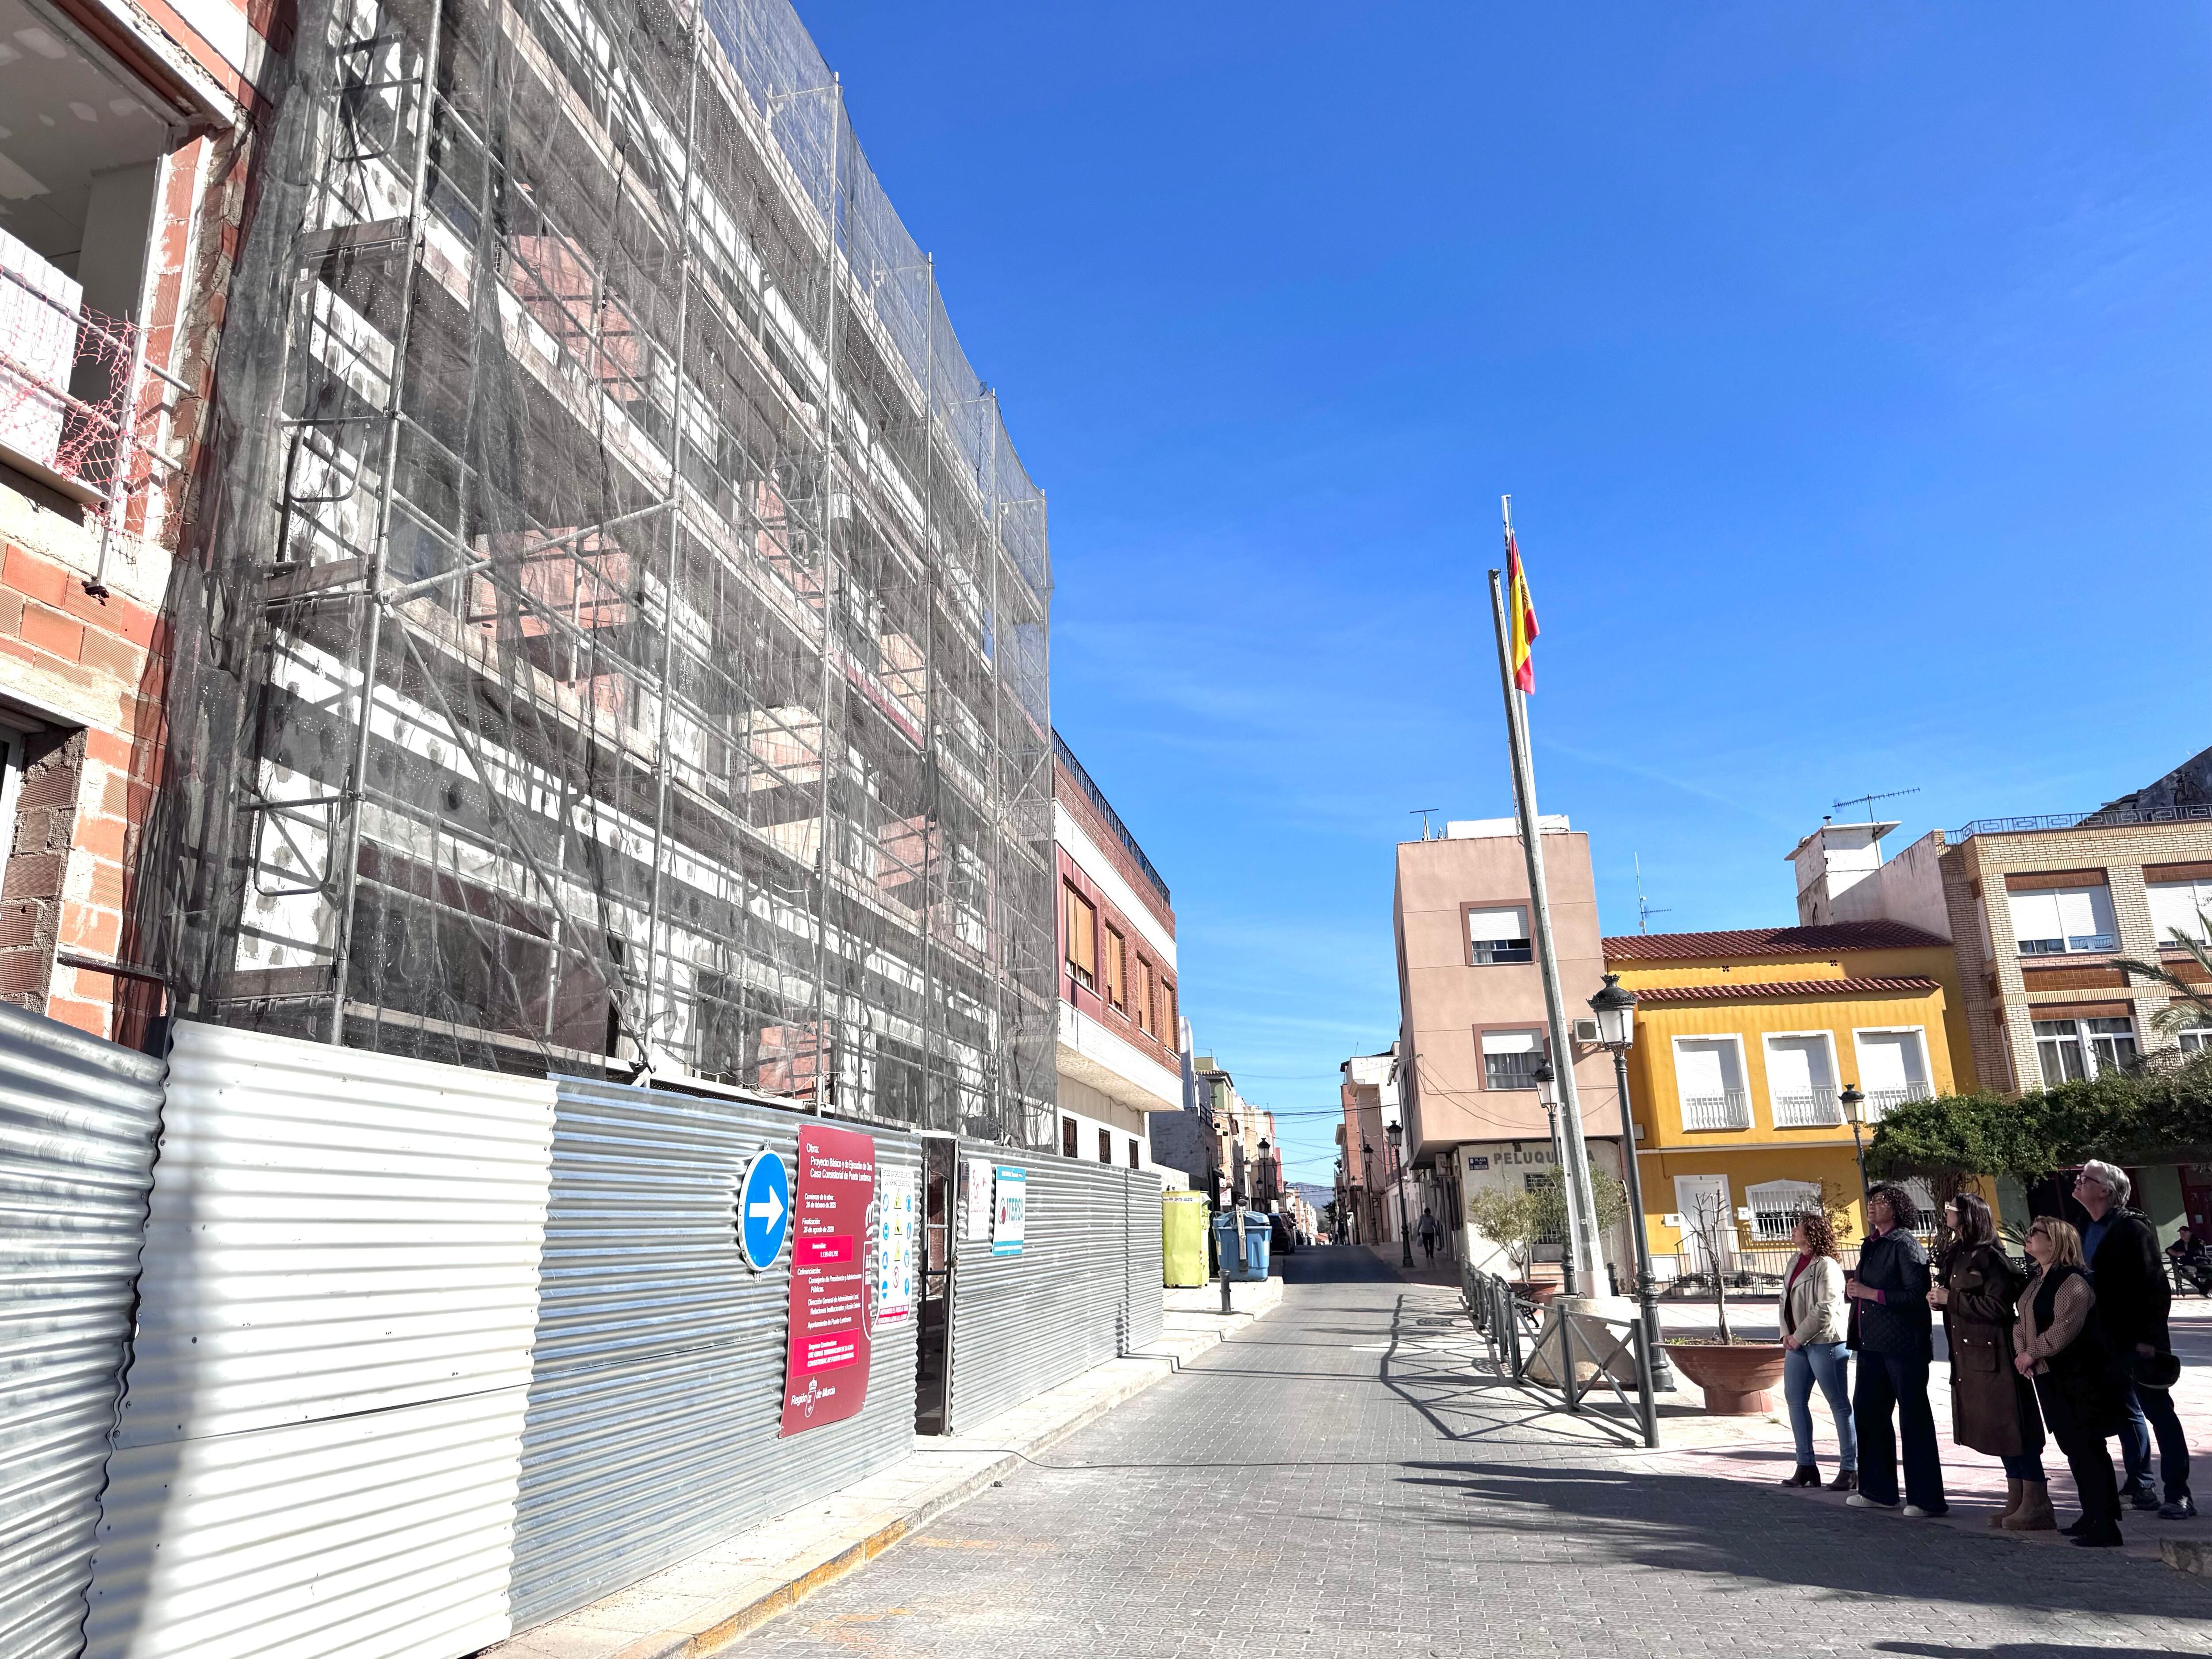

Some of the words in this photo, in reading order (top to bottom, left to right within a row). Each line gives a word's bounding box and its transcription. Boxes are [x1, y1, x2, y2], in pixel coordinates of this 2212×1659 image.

[806, 1143, 819, 1153] Obra:
[810, 1156, 829, 1168] Proyecto
[830, 1158, 841, 1167] Básico
[810, 1168, 822, 1178] Casa
[822, 1169, 844, 1179] Consistorial
[844, 1171, 849, 1180] de
[849, 1171, 858, 1181] Puerto
[791, 1393, 807, 1406] Región
[816, 1389, 822, 1399] de
[822, 1386, 835, 1397] Murcia
